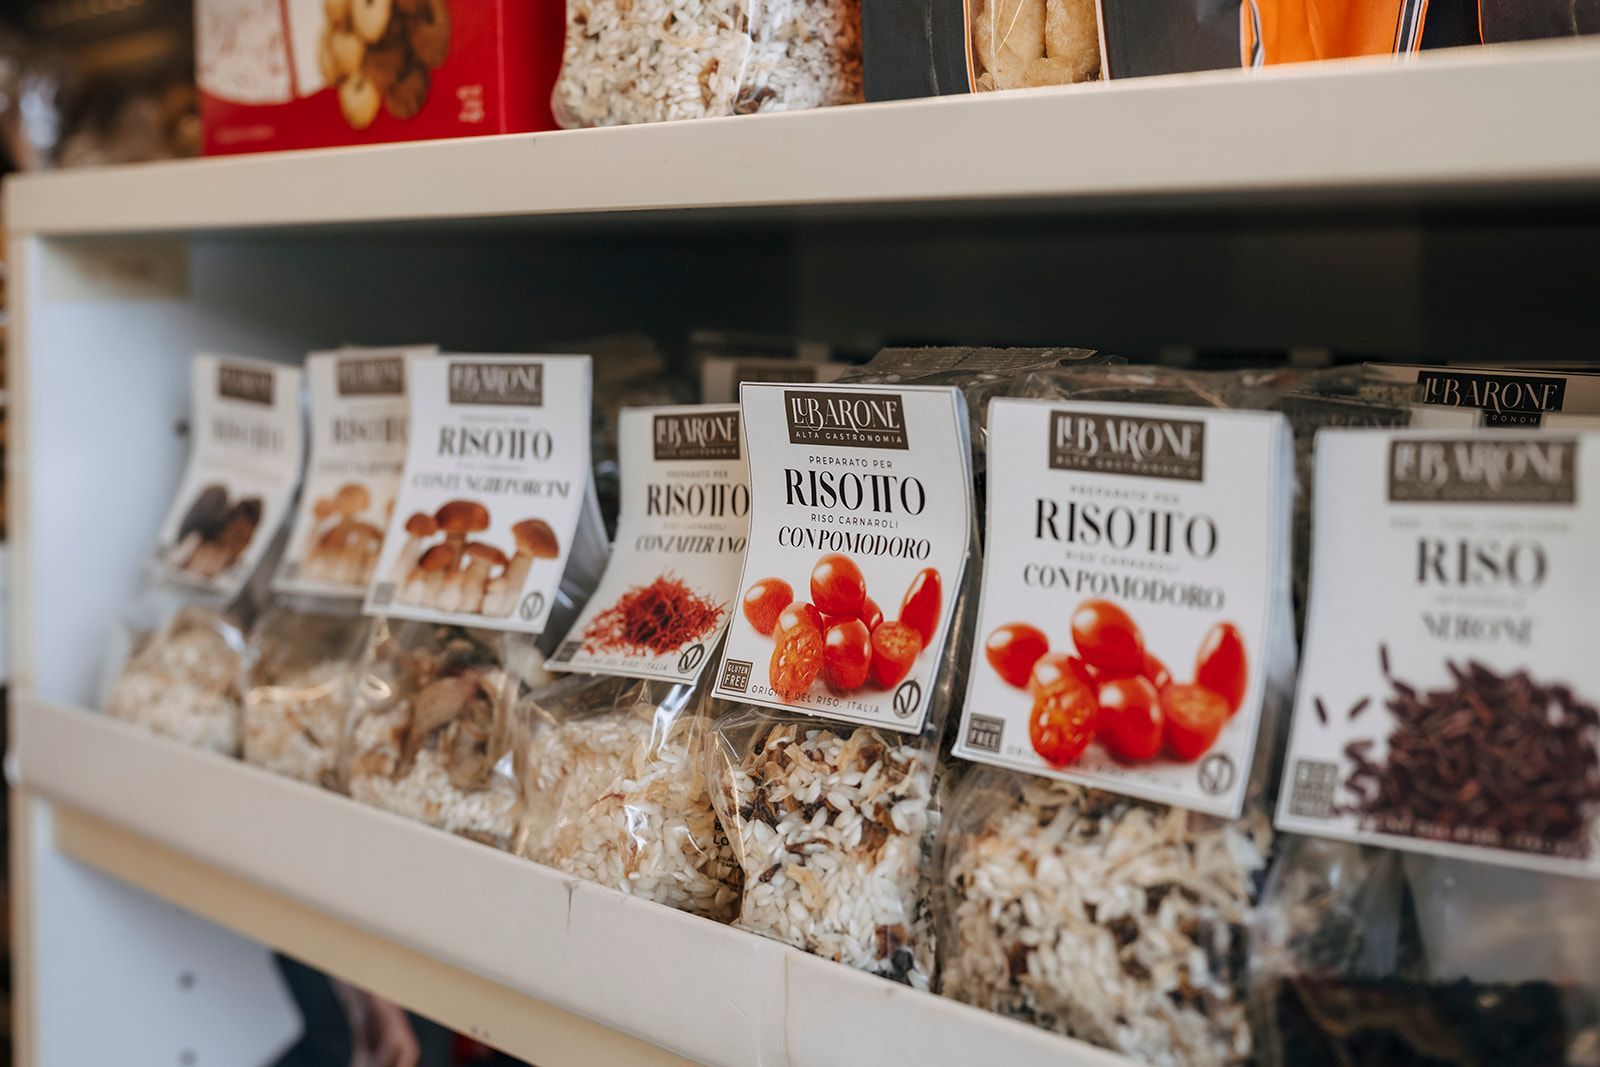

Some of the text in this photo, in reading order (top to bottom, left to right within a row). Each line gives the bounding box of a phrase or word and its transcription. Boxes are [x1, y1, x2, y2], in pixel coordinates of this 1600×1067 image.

[437, 426, 553, 461] RISOTTO
[795, 431, 902, 443] ALTA GASTRONOMIA
[809, 456, 893, 469] PREPARATO PER
[646, 484, 750, 518] RISOTTO
[784, 468, 926, 516] RISOTTO
[811, 513, 899, 529] RISO CARNAROLI
[1035, 499, 1219, 561] RISOTTO
[1414, 536, 1550, 593] RISO
[724, 674, 746, 688] FREE
[727, 664, 749, 674] GLUTEN
[752, 684, 790, 699] ORIGINE
[795, 693, 811, 703] DEL
[847, 701, 880, 714] ITALIA
